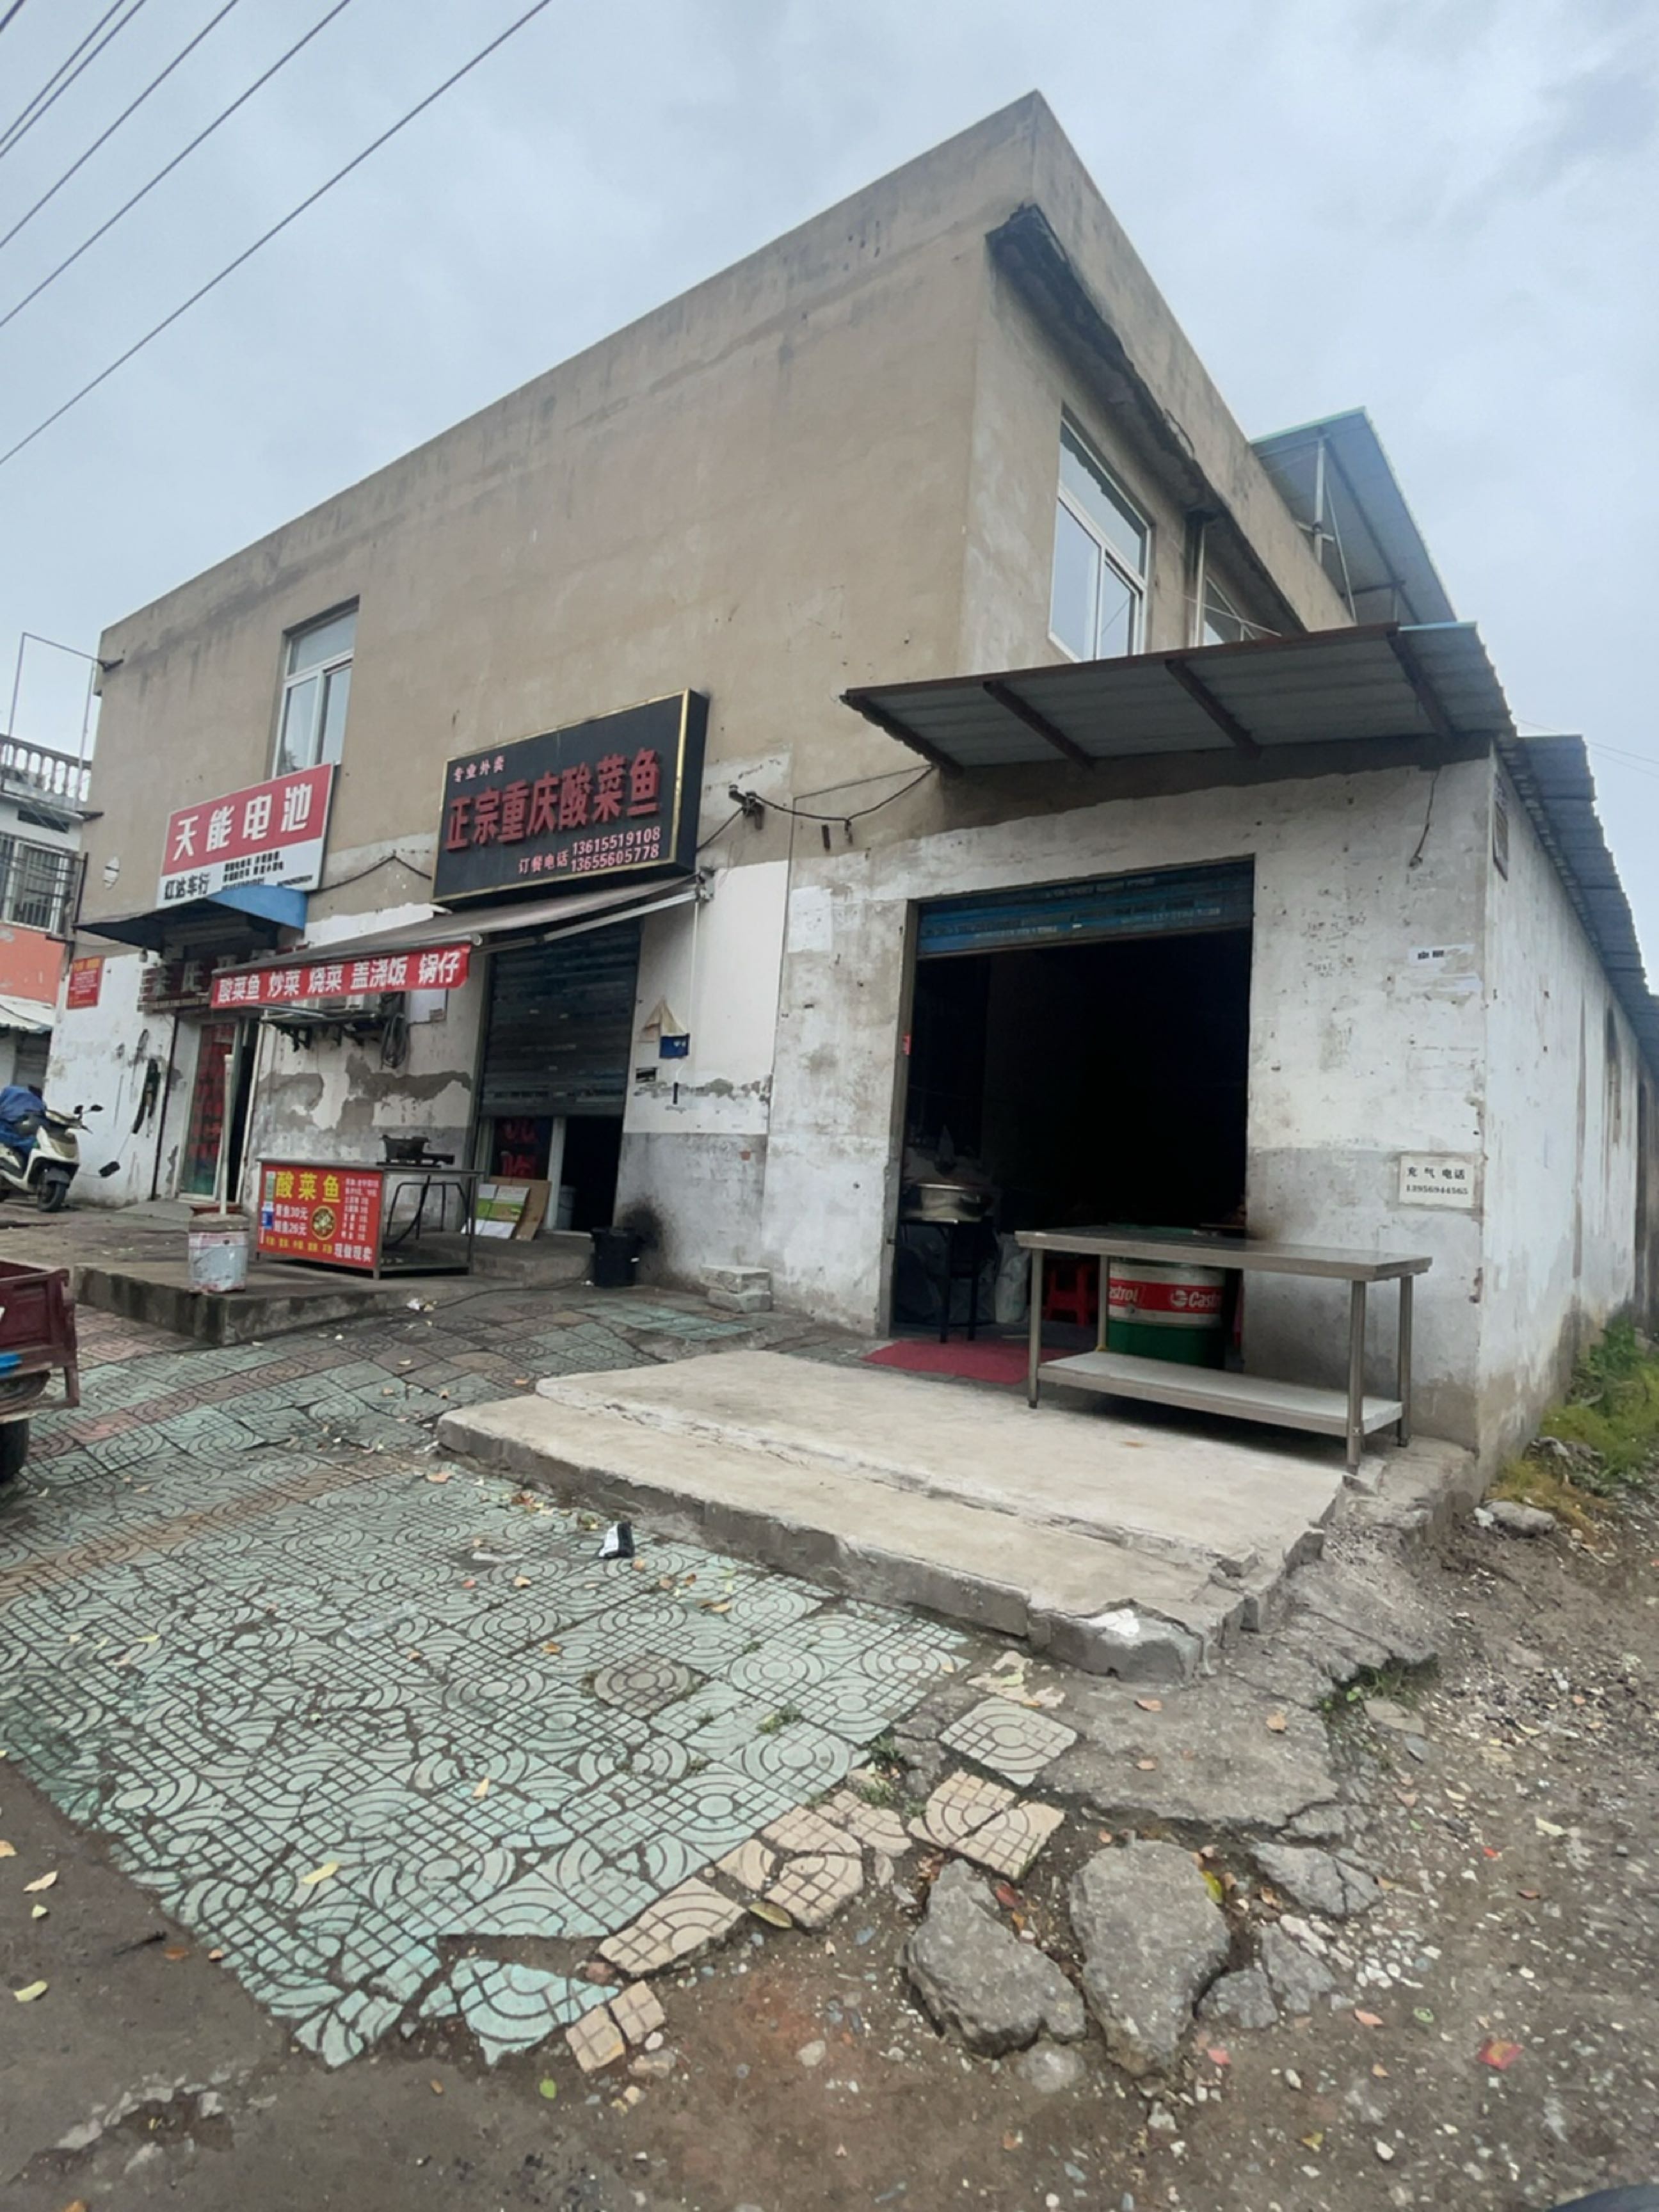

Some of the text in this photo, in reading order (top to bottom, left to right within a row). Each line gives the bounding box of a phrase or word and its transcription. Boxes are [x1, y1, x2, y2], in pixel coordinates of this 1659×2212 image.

[446, 748, 661, 850] 正宗重庆酸菜鱼
[173, 783, 312, 861] 天能电池
[572, 826, 661, 855] 13615519108
[518, 849, 568, 875] 订餐电话
[571, 843, 660, 872] 13655605778
[218, 974, 260, 1003] 酸菜鱼
[267, 968, 302, 998] 炒菜
[307, 964, 344, 993] 烧菜
[350, 956, 409, 990] 盖浇饭
[419, 951, 462, 984] 锅仔
[276, 1171, 341, 1203] 酸菜鱼
[1109, 1286, 1139, 1302] astrol
